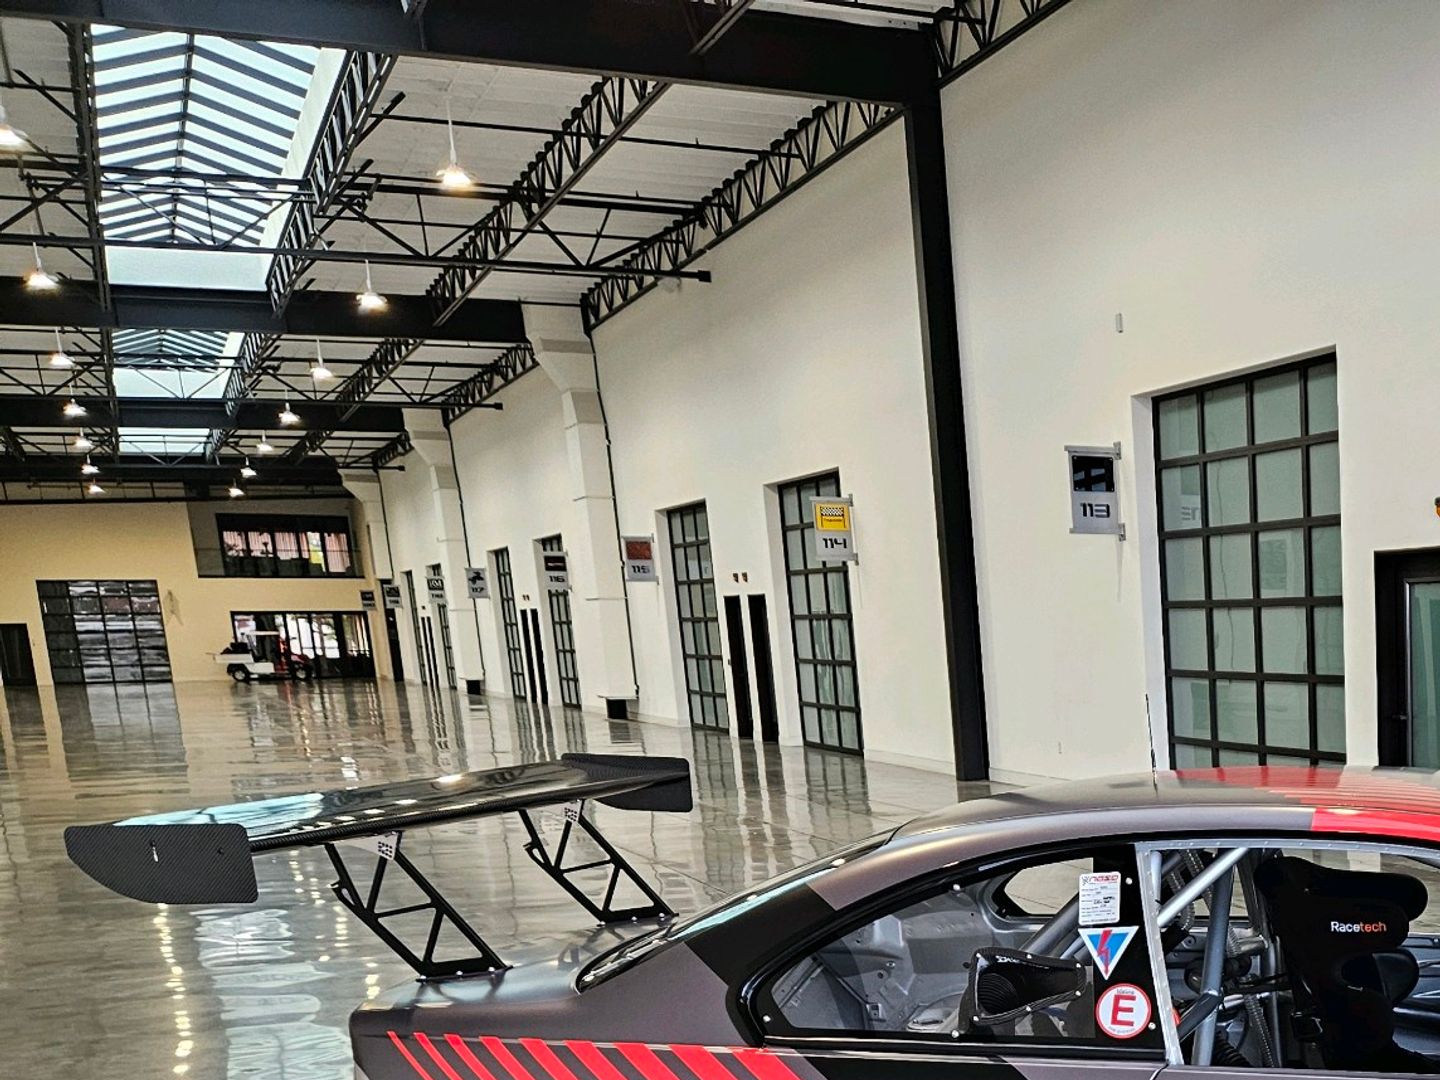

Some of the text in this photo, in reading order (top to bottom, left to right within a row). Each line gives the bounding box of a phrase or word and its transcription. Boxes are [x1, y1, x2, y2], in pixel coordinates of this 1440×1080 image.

[1080, 503, 1110, 518] 113
[823, 538, 848, 549] 114
[1330, 920, 1387, 933] Racetech
[1111, 994, 1137, 1027] E
